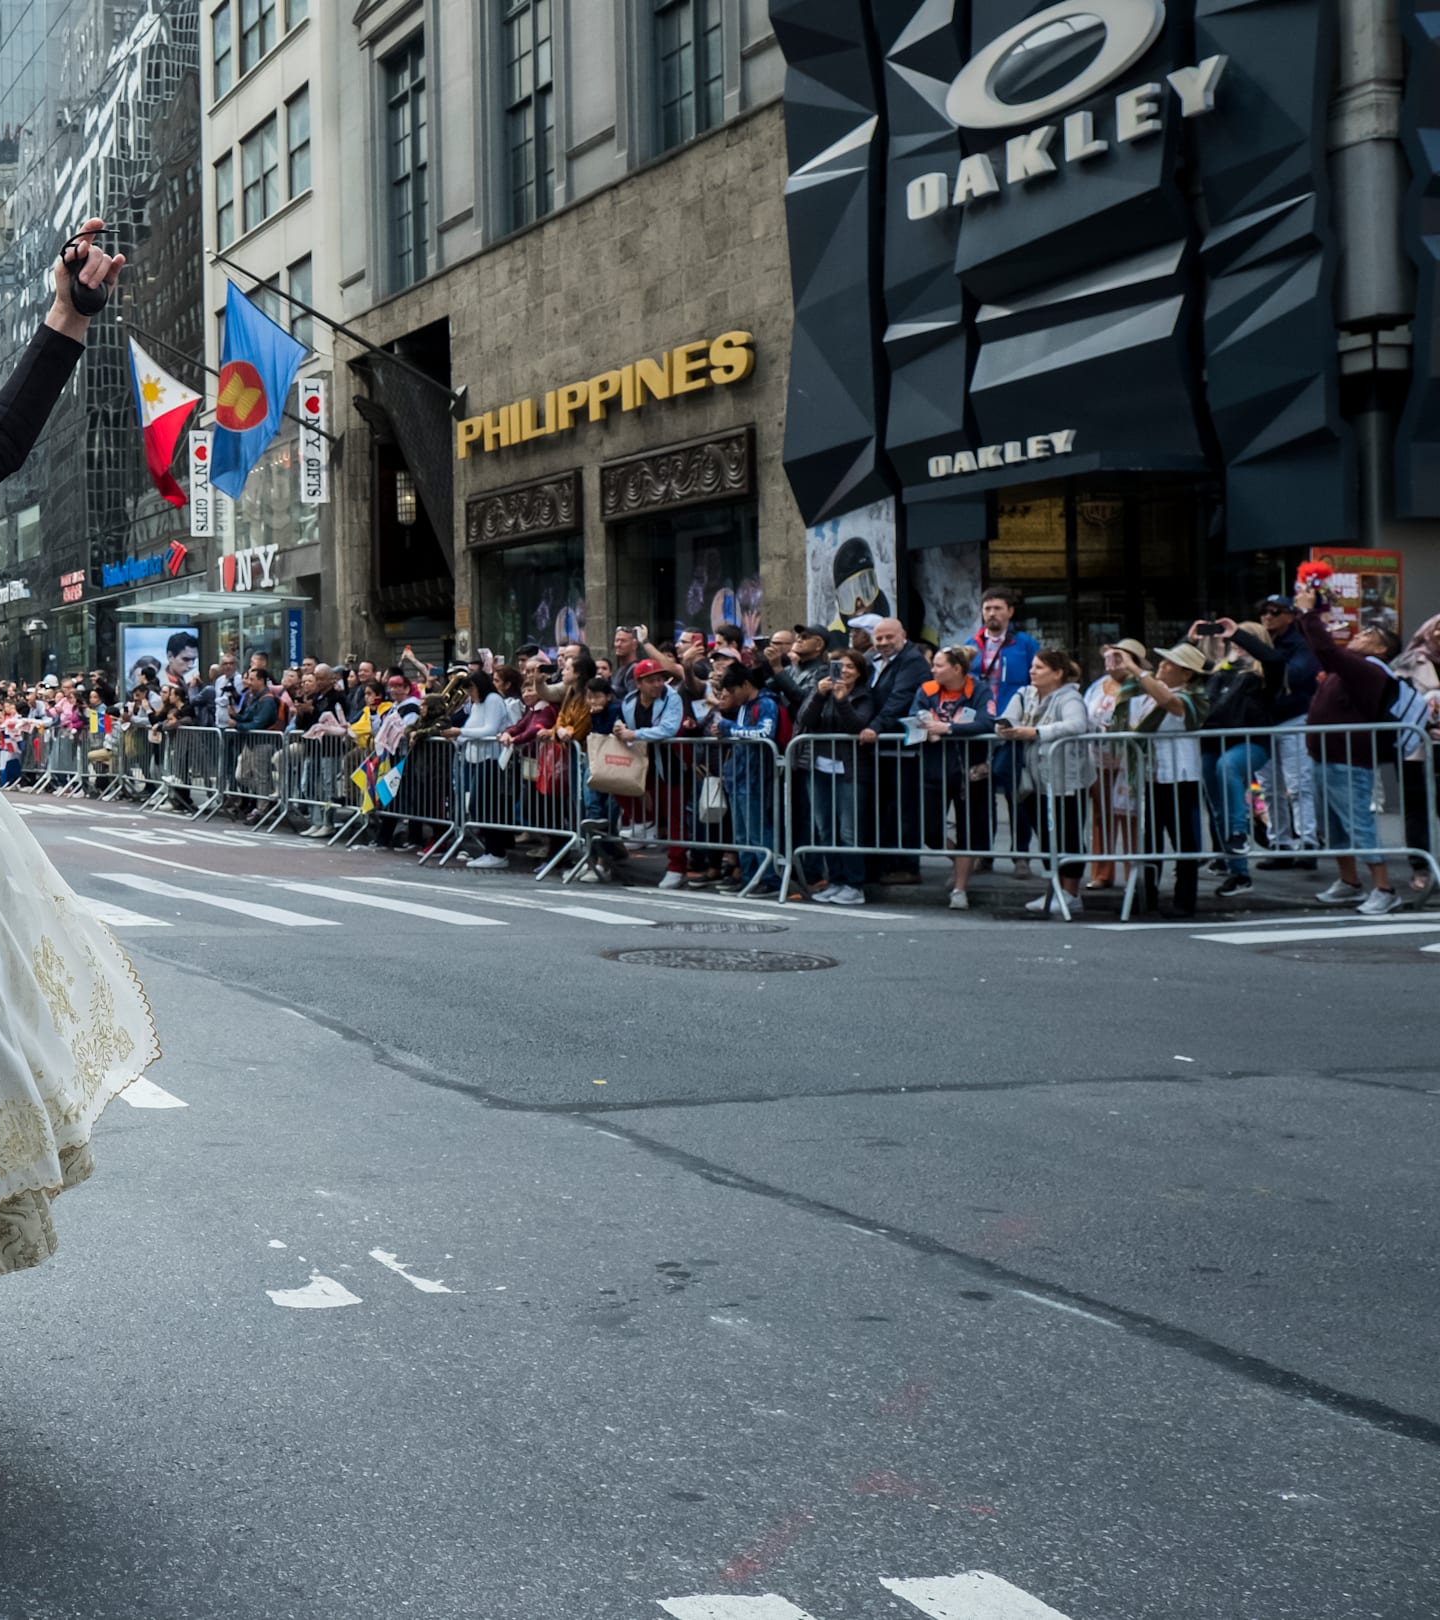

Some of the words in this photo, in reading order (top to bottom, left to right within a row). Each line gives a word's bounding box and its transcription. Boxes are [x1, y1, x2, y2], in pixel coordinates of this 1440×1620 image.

[906, 54, 1229, 221] OAKLEY
[304, 385, 320, 394] I
[457, 330, 755, 460] PHILIPPINES
[927, 429, 1077, 478] OAKLEY
[195, 463, 208, 493] NY
[306, 458, 322, 497] GIFTS
[195, 499, 209, 532] GIFTS
[235, 543, 279, 592] NY
[289, 629, 298, 657] Avenue
[89, 826, 328, 848] BUS
